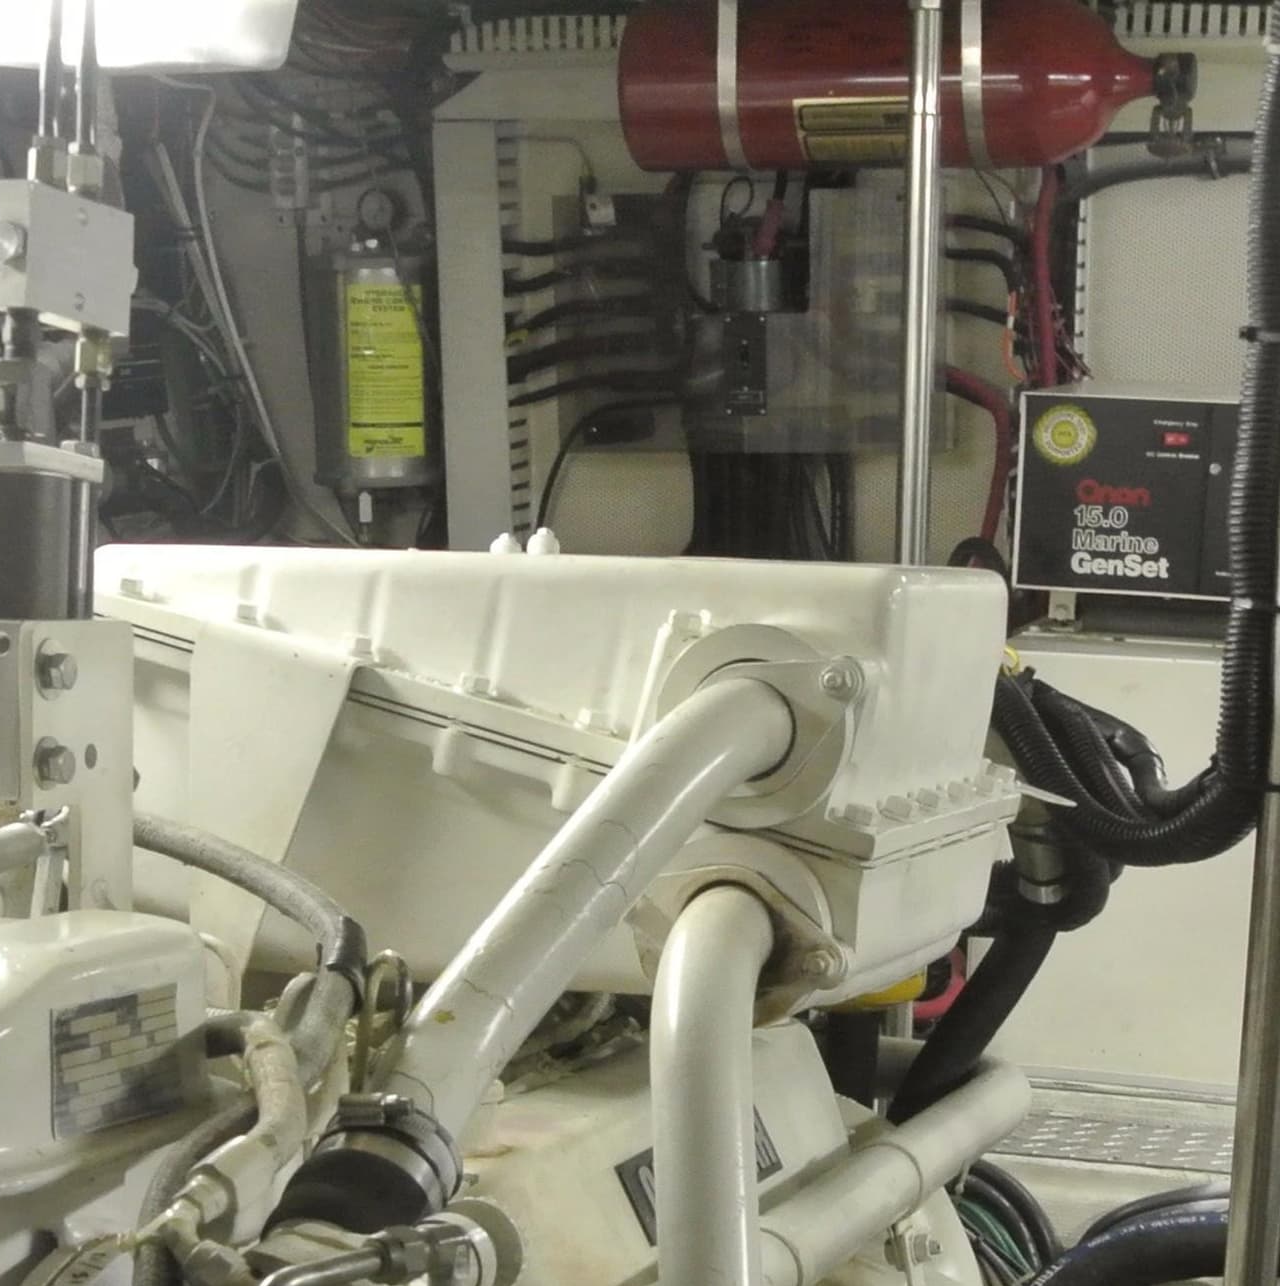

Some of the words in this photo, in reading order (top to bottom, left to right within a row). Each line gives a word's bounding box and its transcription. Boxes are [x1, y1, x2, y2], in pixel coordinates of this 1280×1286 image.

[1077, 478, 1152, 506] Onan
[1073, 504, 1129, 529] 15.0
[1071, 528, 1160, 554] Marine
[1071, 551, 1170, 579] GenSet
